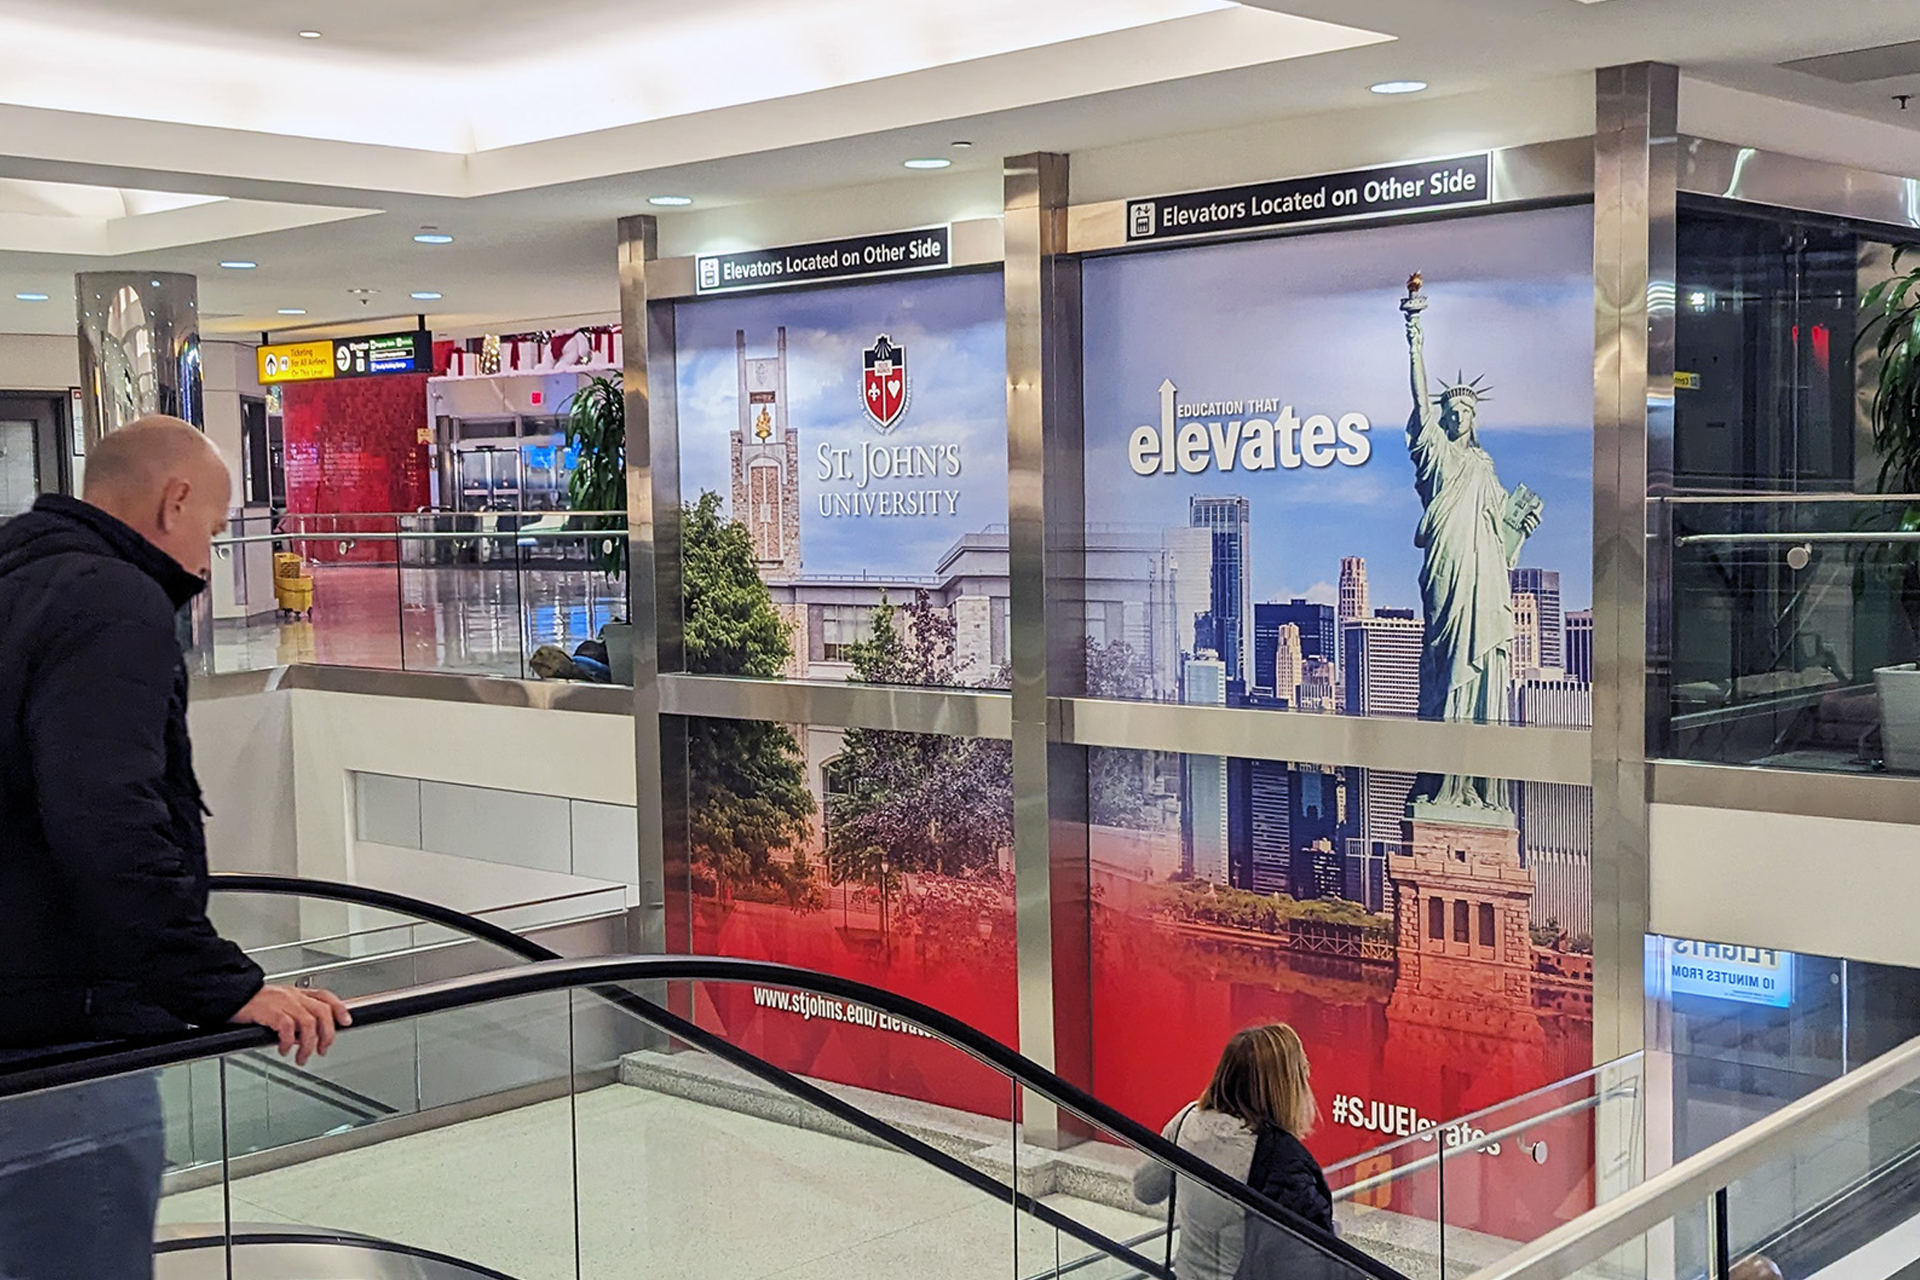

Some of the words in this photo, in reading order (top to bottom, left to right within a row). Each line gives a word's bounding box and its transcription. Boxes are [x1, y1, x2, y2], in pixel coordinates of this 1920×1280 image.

[1163, 201, 1246, 227] Elevators
[1251, 187, 1326, 217] Located
[1331, 187, 1358, 206] on
[1363, 175, 1425, 203] Other
[1430, 168, 1477, 195] Side
[723, 257, 783, 281] Elevators
[786, 250, 838, 274] Located
[842, 250, 860, 267] on
[864, 242, 907, 264] Other
[909, 237, 941, 258] Side
[1128, 377, 1372, 476] elevates
[1177, 401, 1243, 418] EDUCATION
[1248, 397, 1280, 413] THAT
[818, 490, 960, 517] UNIVERSITY
